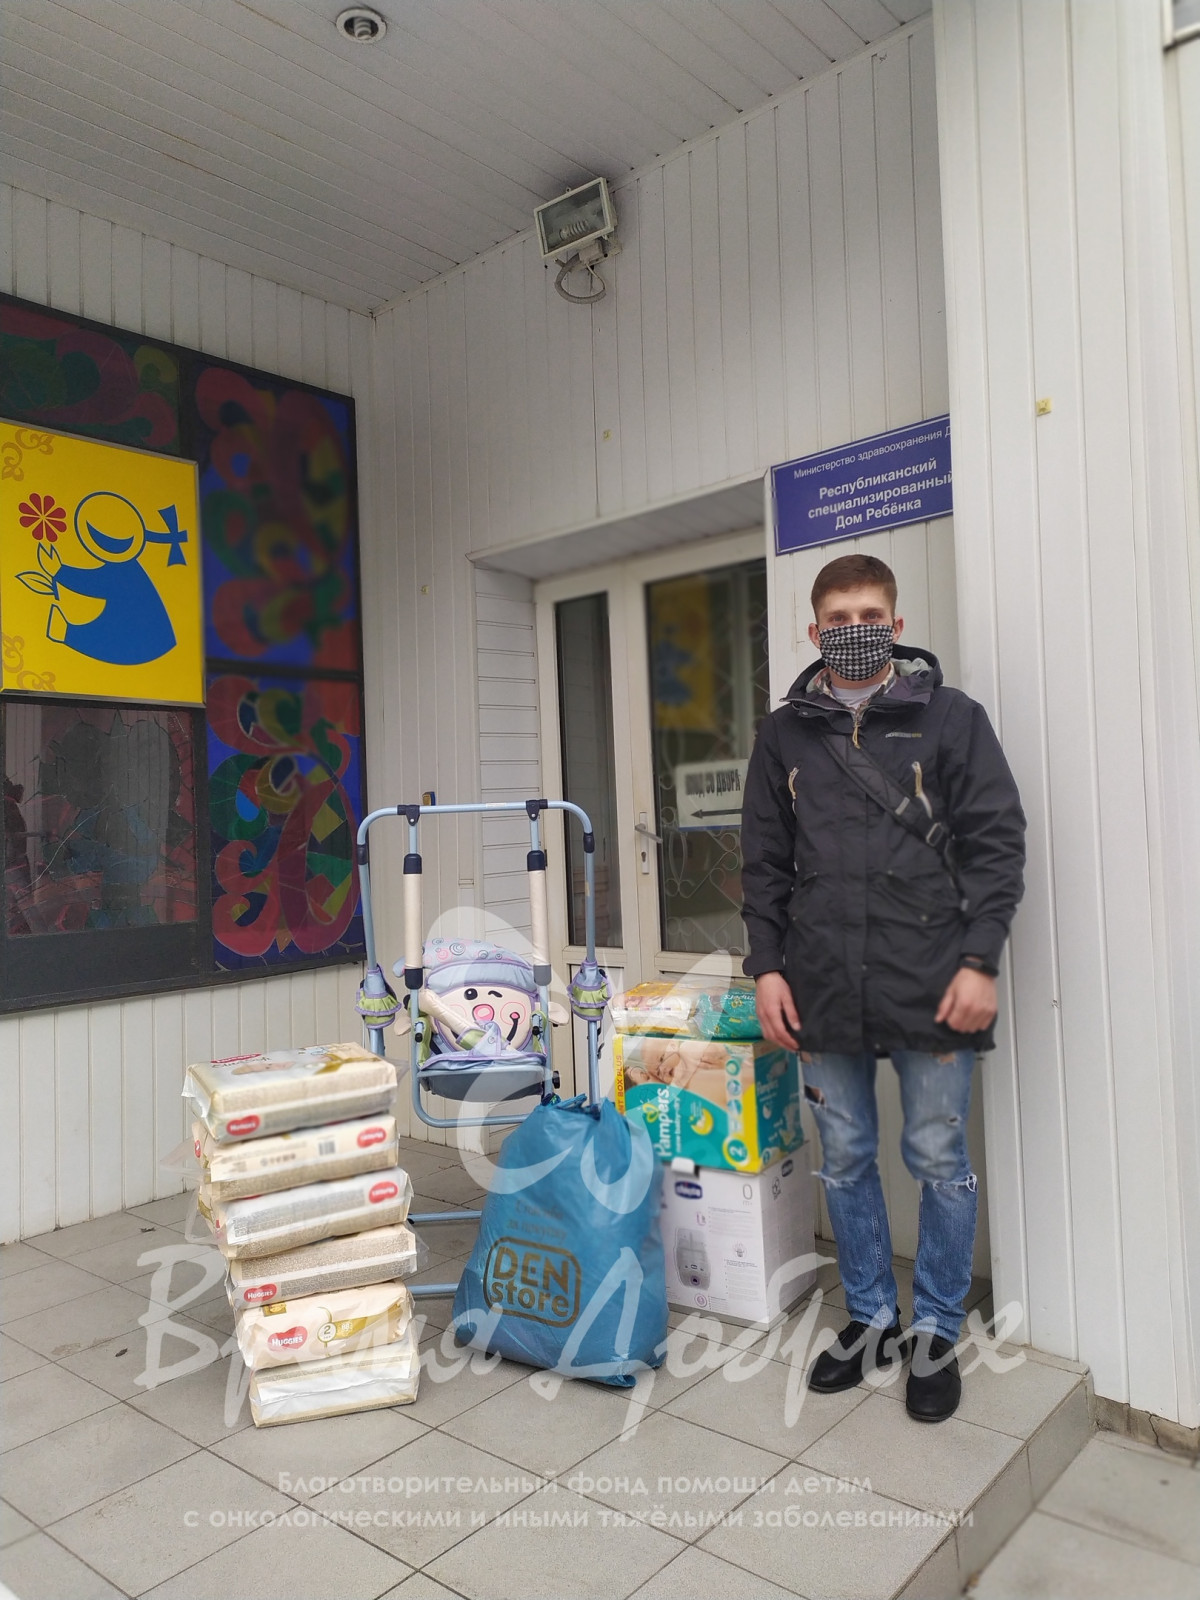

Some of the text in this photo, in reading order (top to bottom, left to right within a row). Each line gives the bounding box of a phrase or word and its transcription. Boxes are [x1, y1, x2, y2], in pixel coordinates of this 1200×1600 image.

[793, 452, 855, 479] Министерство
[857, 429, 942, 462] здравоохранения
[819, 457, 937, 500] Республиканский
[835, 497, 922, 530] Дом Ребёнка
[653, 1088, 674, 1157] Pampers
[729, 1145, 743, 1158] 2
[493, 1246, 570, 1295] DEN
[490, 1279, 570, 1318] store
[323, 1324, 332, 1335] 2
